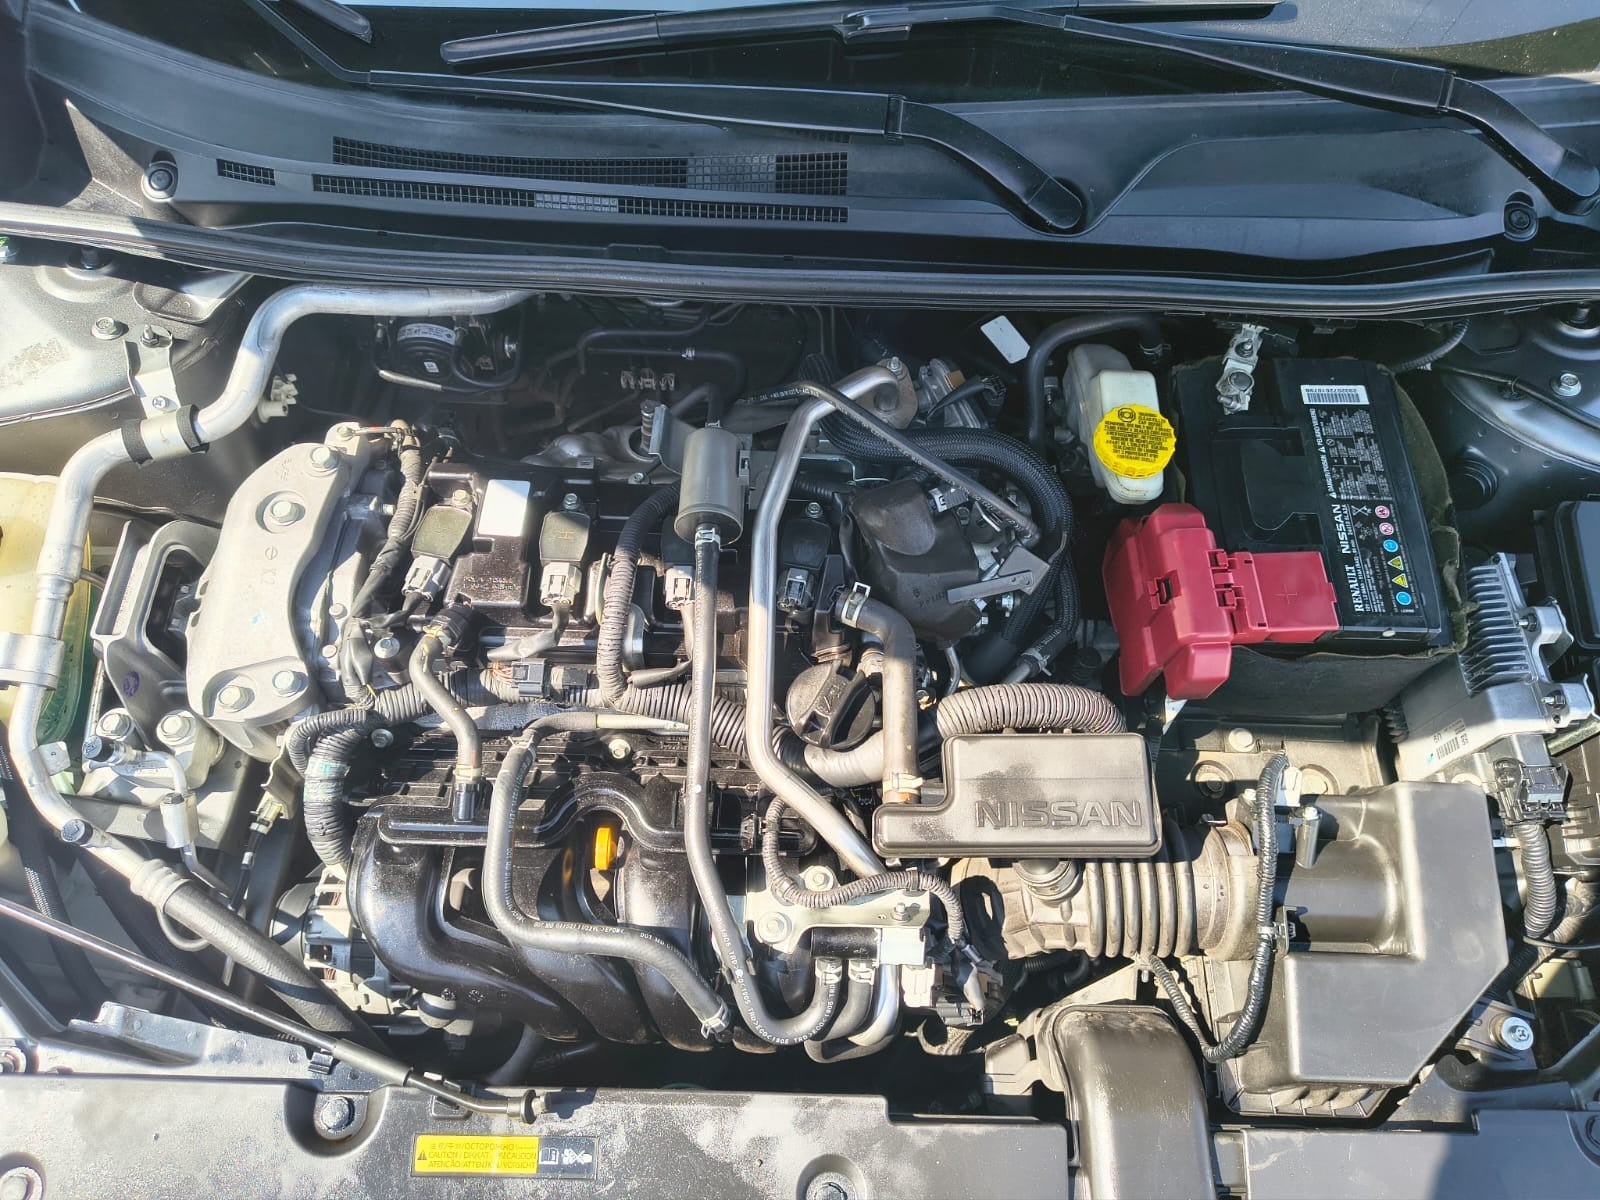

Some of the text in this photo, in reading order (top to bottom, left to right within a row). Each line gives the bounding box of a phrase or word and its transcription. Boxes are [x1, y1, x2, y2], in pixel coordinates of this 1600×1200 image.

[1332, 504, 1364, 612] RENAULT NISSAN
[975, 801, 1142, 828] NISSAN
